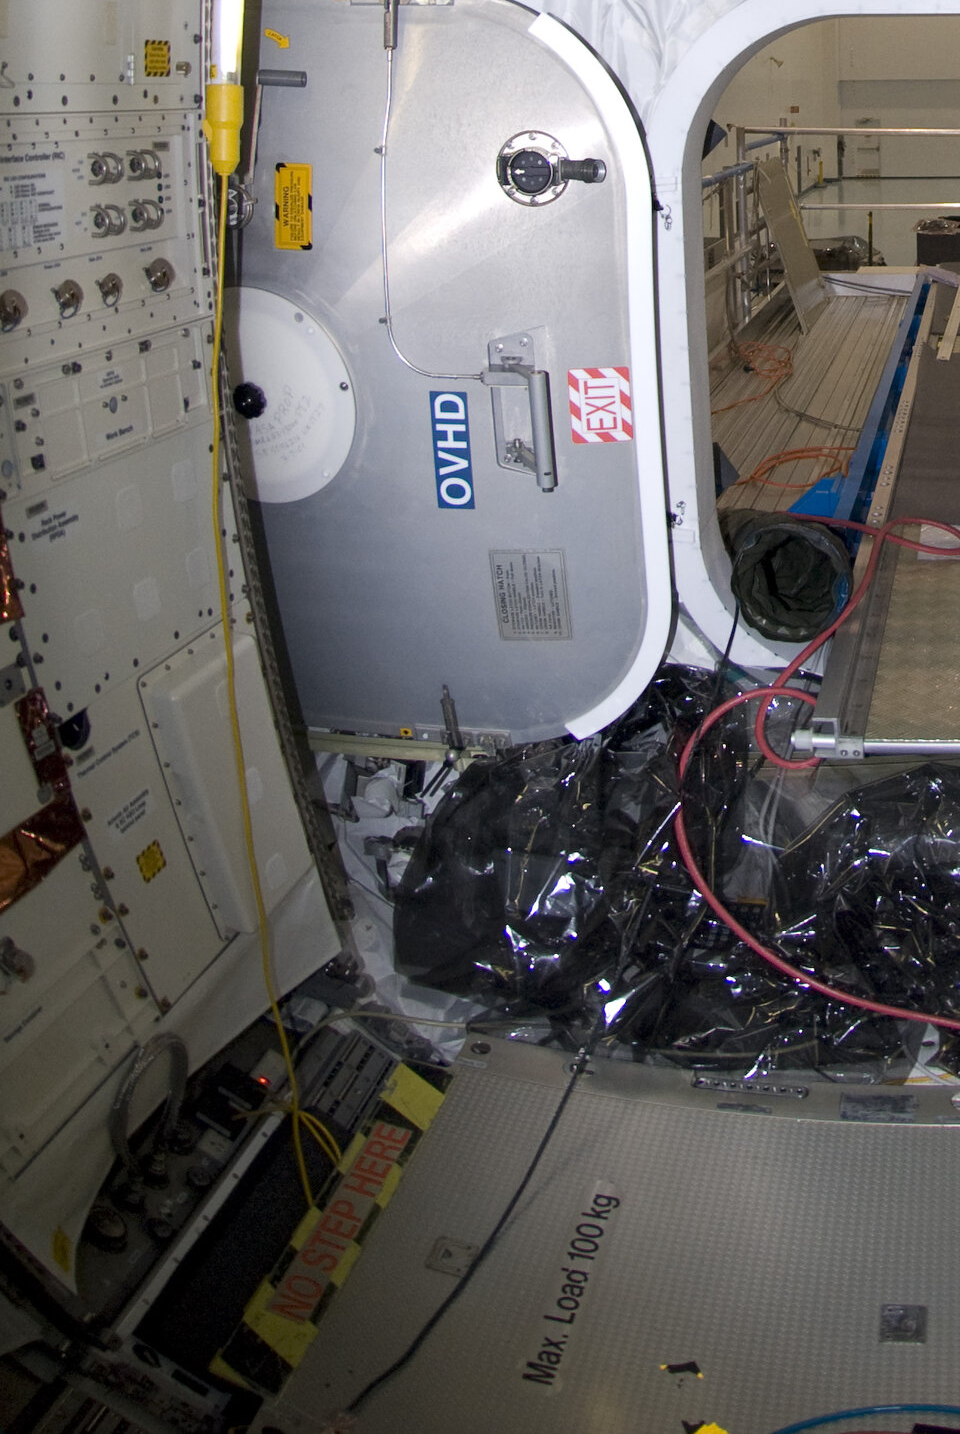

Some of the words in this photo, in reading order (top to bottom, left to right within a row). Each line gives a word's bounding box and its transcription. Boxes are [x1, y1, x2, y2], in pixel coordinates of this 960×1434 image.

[585, 380, 617, 432] EXIT
[434, 393, 472, 506] OVHD
[496, 565, 504, 590] HATCH
[499, 592, 509, 623] CLOSING
[269, 1273, 324, 1323] NO
[302, 1199, 362, 1272] STEP
[352, 1123, 412, 1197] HERE
[580, 1192, 621, 1220] kg
[566, 1222, 605, 1262] 100
[544, 1267, 589, 1326] Load
[521, 1332, 570, 1387] Max.
